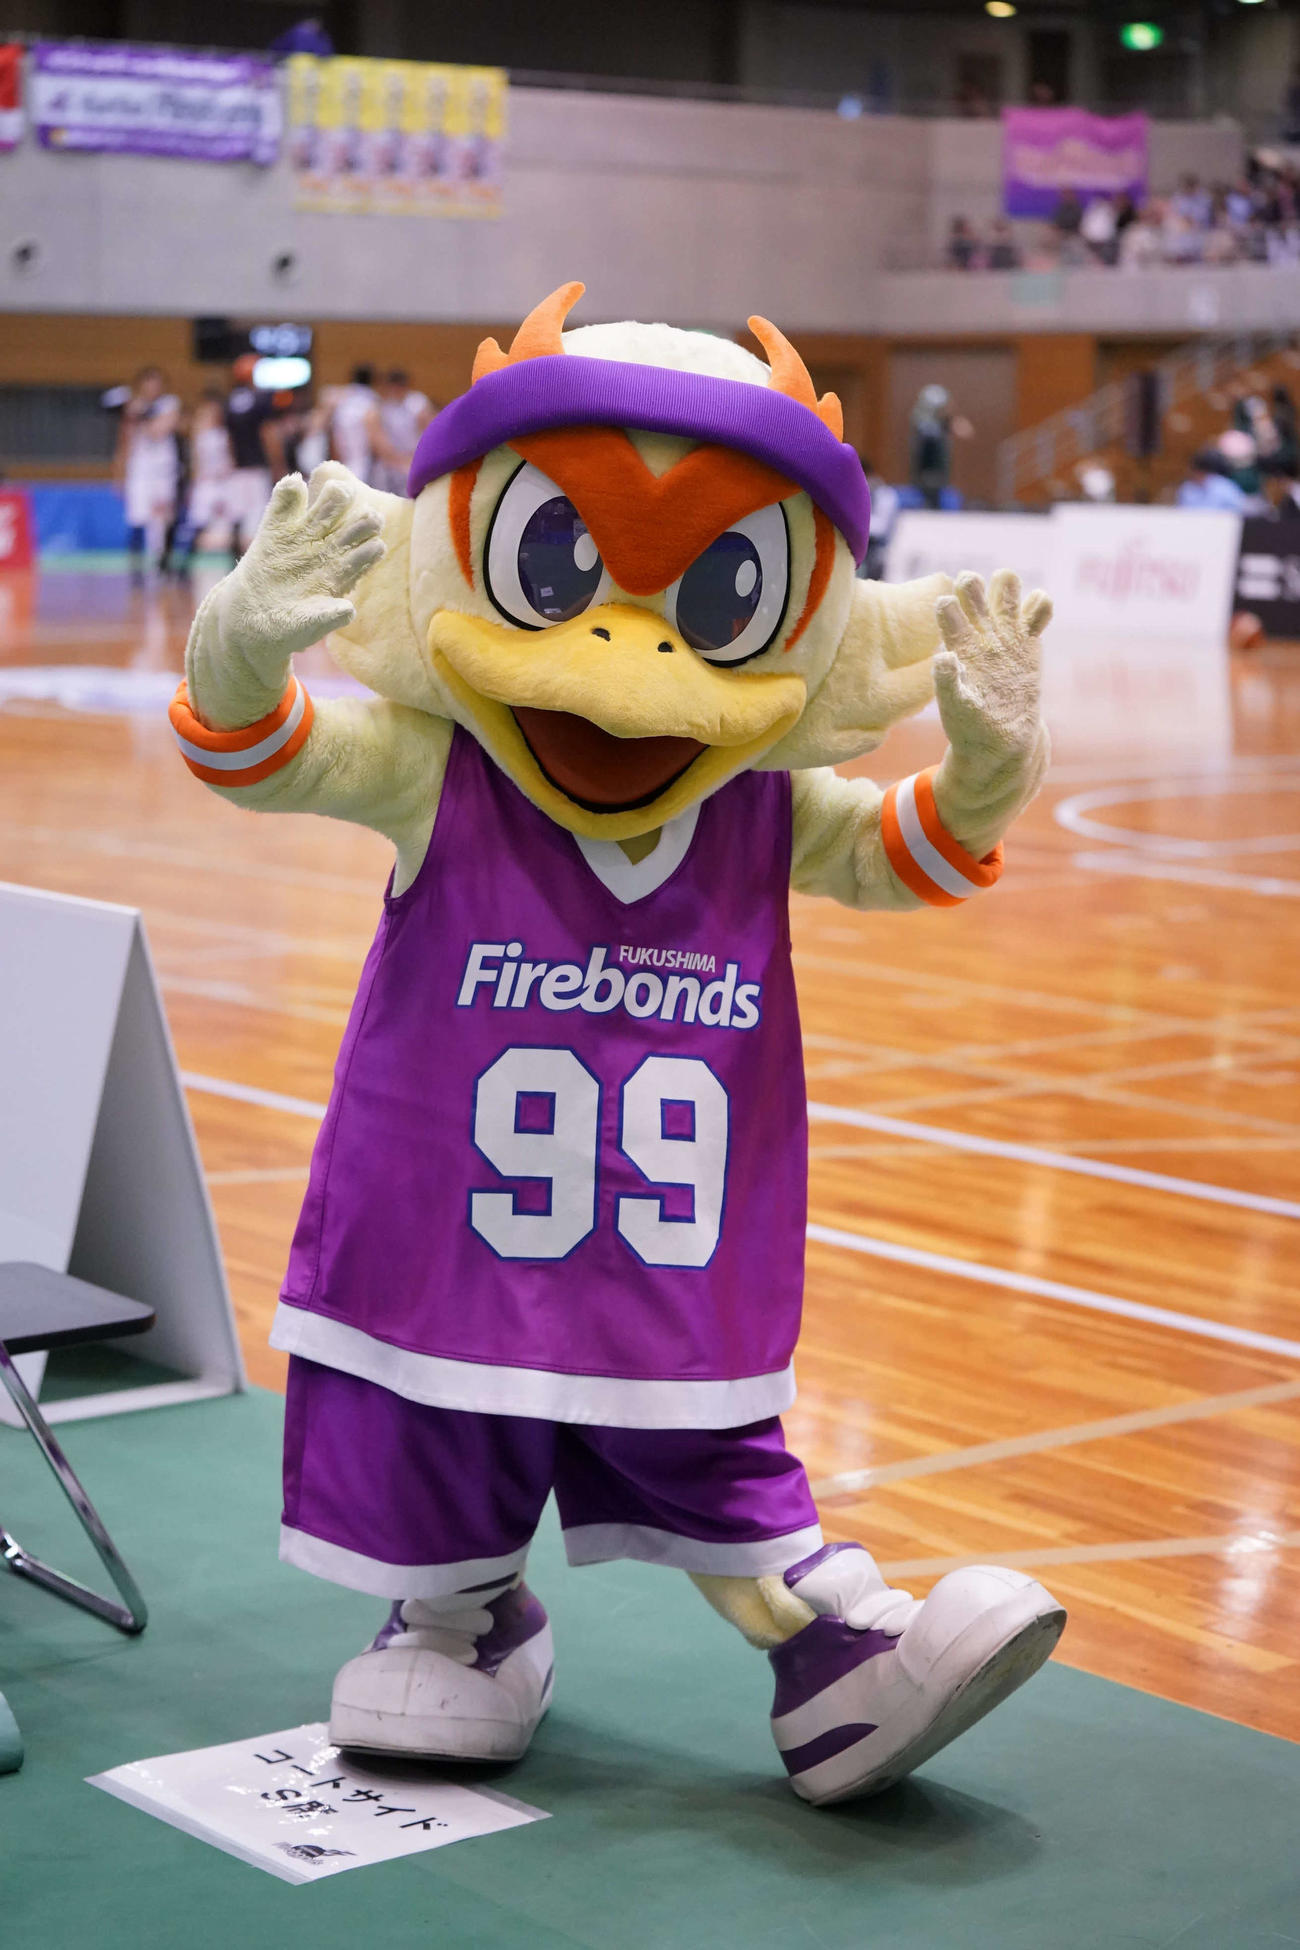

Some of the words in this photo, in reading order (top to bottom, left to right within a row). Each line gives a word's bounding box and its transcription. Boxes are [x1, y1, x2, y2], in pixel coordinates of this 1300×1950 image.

[457, 942, 762, 1030] Firebonds
[619, 945, 716, 973] FUKUSHIMA
[469, 1045, 730, 1270] 99
[254, 1750, 449, 1830] コートサイド
